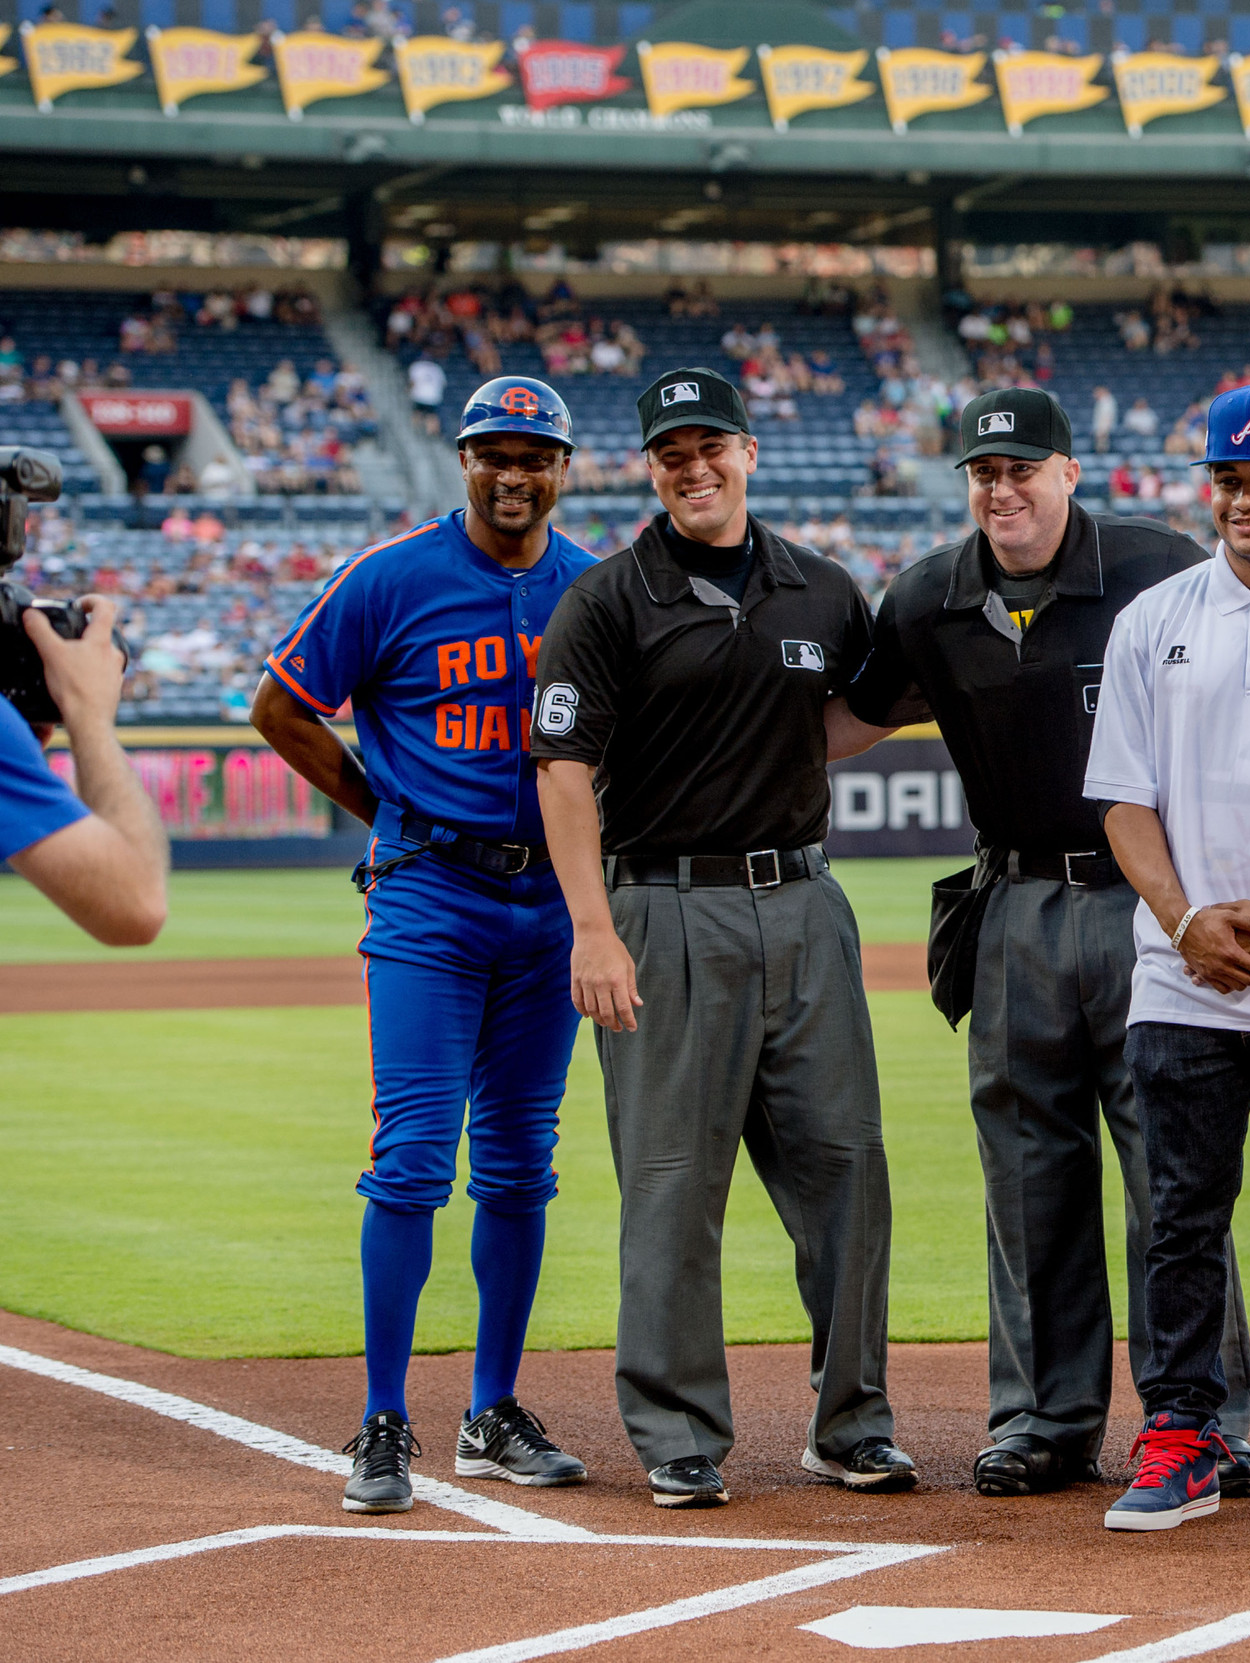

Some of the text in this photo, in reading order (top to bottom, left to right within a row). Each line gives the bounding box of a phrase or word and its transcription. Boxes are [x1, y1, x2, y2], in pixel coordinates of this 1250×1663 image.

[1162, 658, 1191, 666] RUSSELL
[530, 683, 579, 736] 6
[829, 770, 964, 833] DAI
